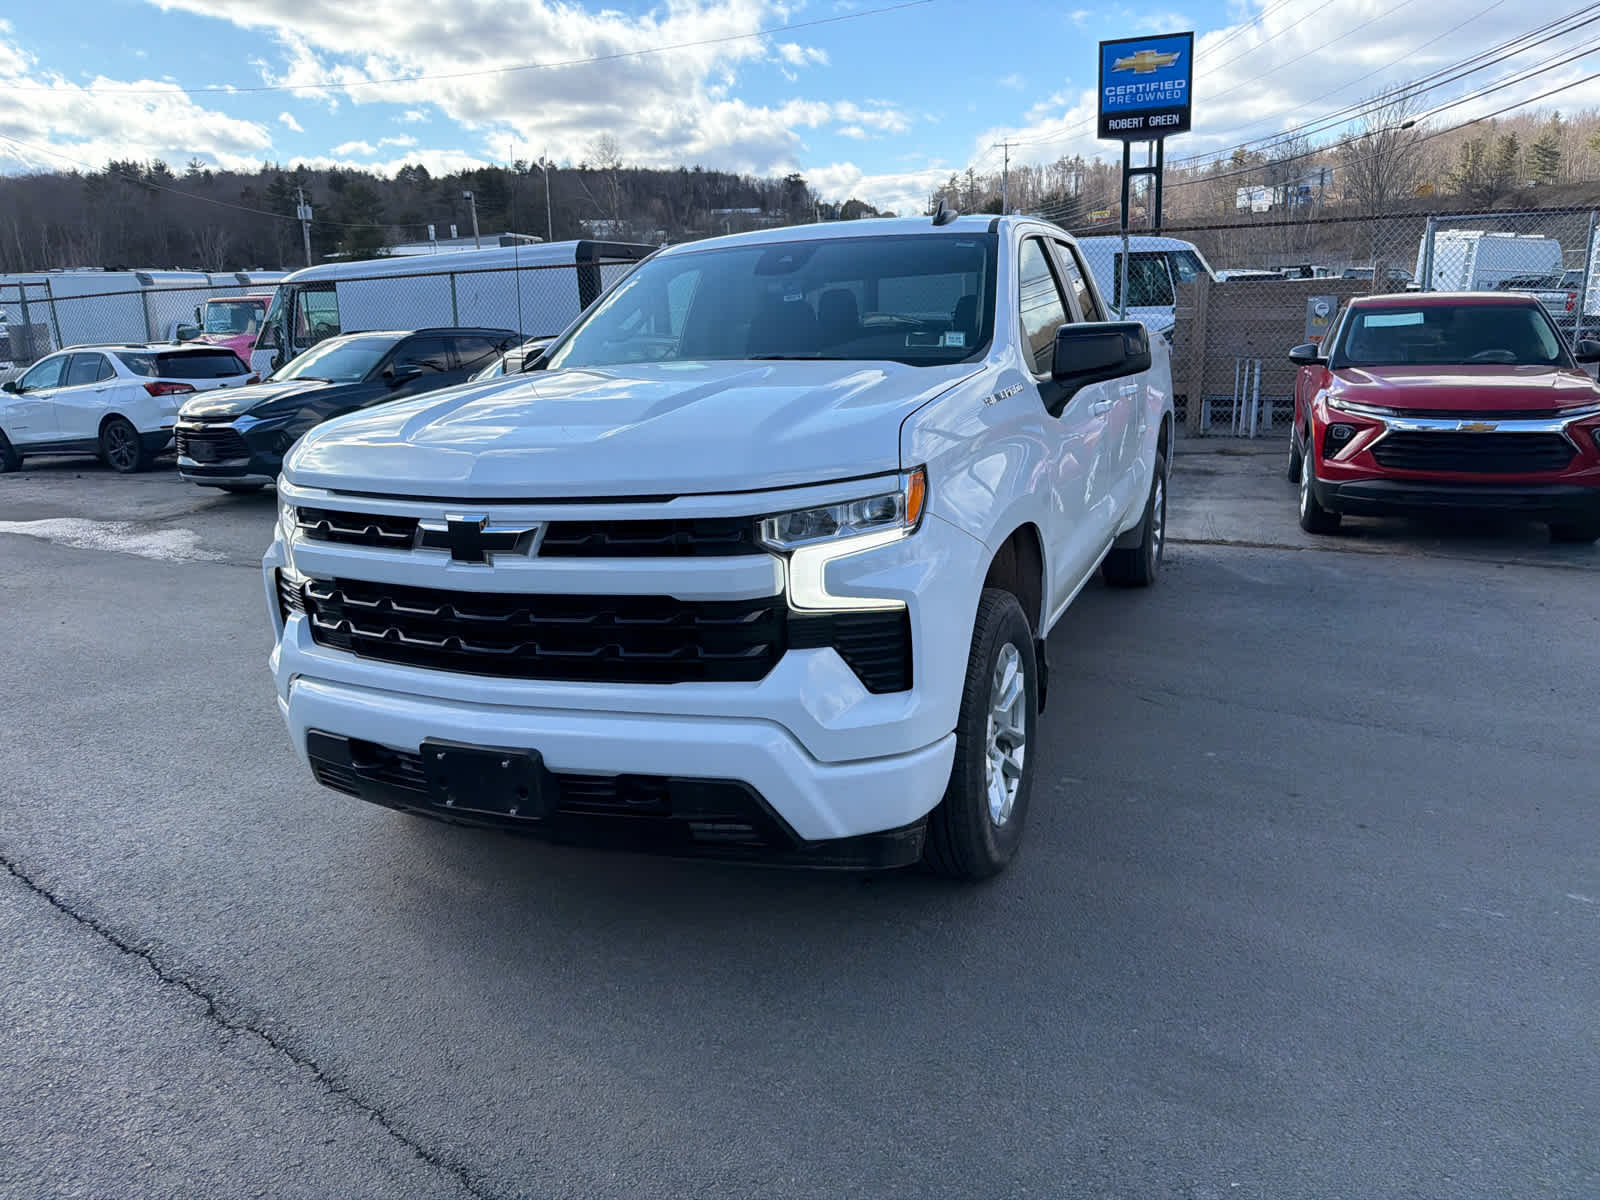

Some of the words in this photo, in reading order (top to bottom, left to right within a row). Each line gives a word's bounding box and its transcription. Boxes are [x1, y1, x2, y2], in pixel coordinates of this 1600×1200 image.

[1105, 79, 1186, 96] CERTIFIED
[1108, 89, 1181, 104] PRE-OWNED
[1109, 117, 1144, 130] ROBERT
[1149, 114, 1179, 127] GREEN
